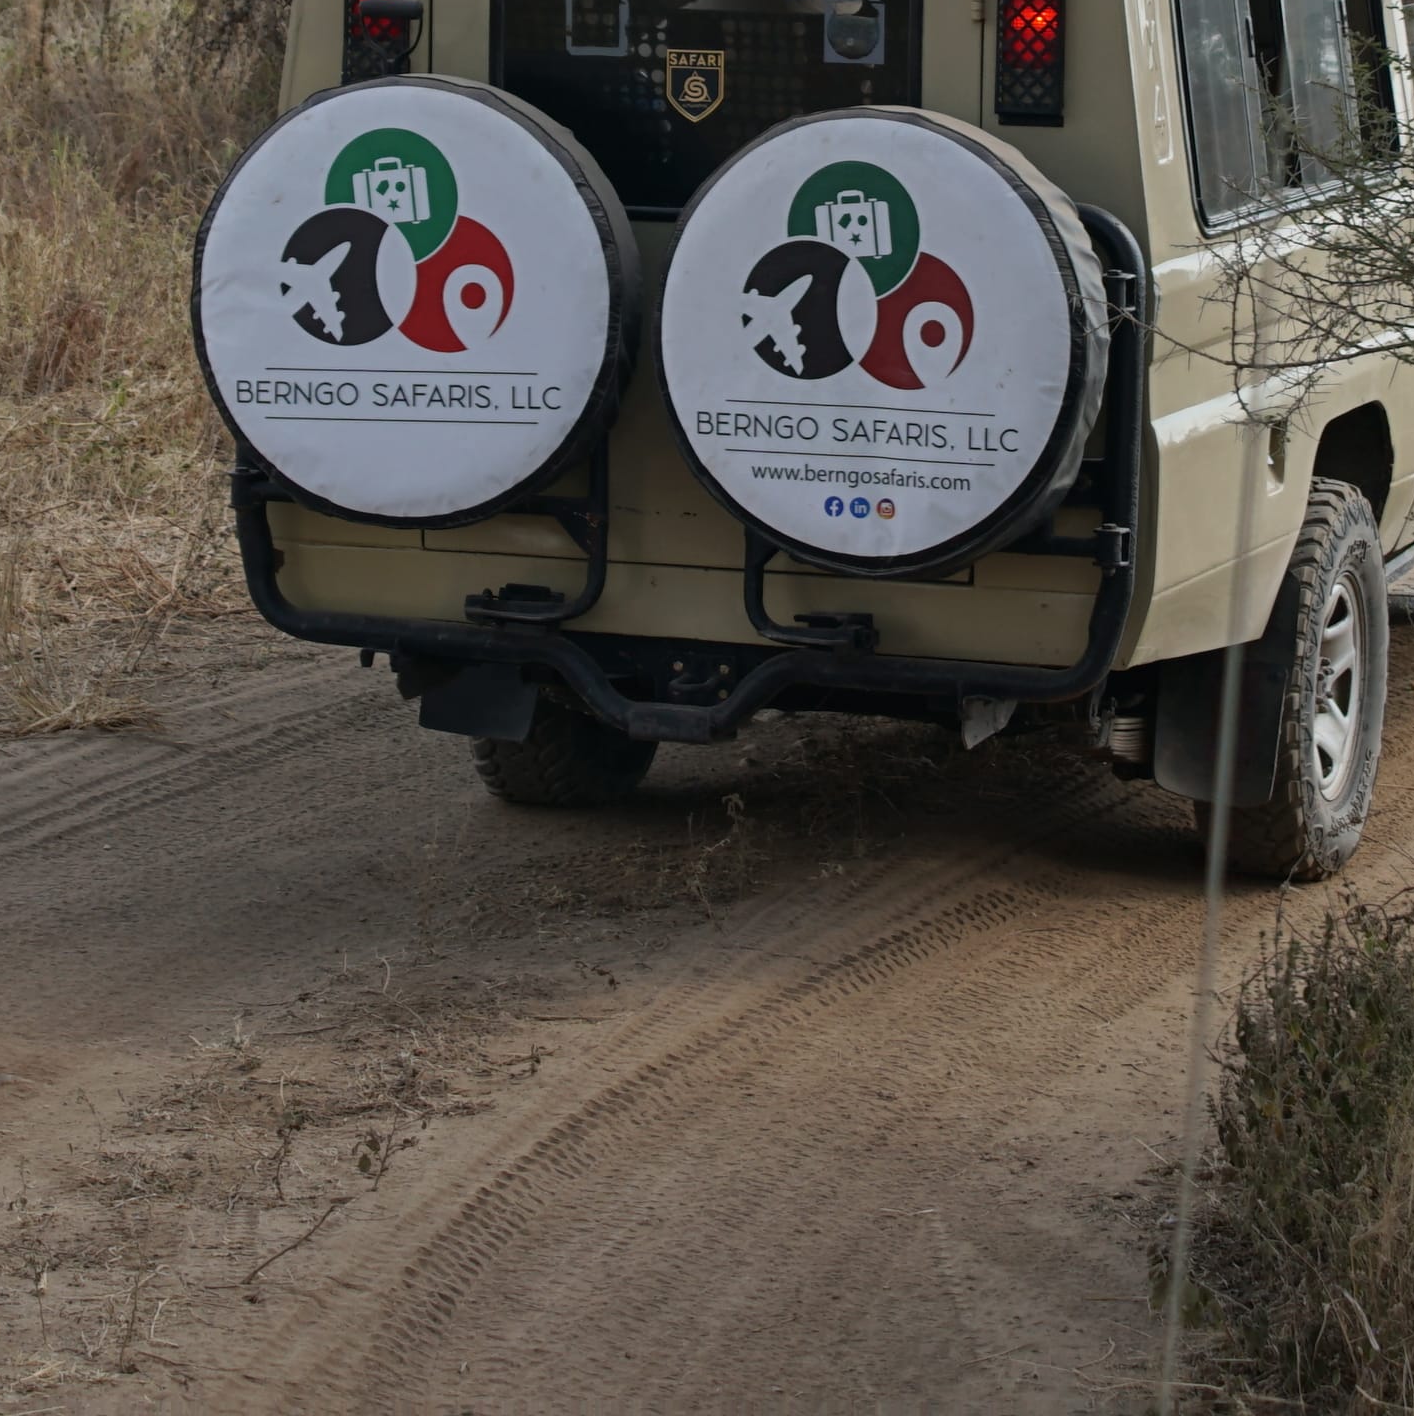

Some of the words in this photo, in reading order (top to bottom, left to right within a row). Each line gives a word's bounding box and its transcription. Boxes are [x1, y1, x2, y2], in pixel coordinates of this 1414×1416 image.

[669, 53, 721, 67] SAFARI
[236, 380, 359, 406] BERNGO
[372, 383, 500, 412] SAFARIS,
[511, 386, 562, 411] LLC
[696, 411, 819, 440] BERNGO
[832, 418, 955, 452] SAFARIS,
[967, 426, 1019, 453] LLC
[751, 464, 972, 492] www.berngosafaris.com
